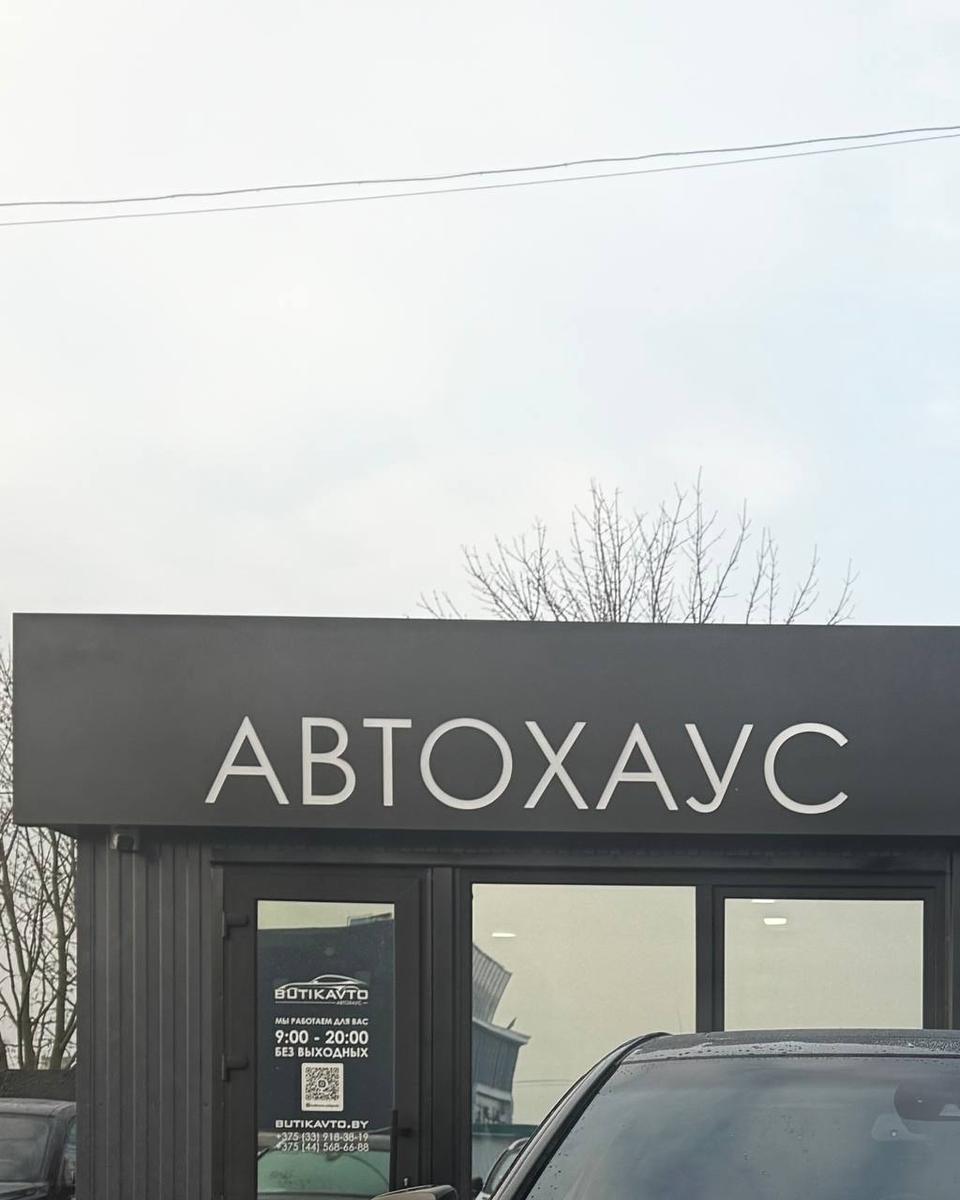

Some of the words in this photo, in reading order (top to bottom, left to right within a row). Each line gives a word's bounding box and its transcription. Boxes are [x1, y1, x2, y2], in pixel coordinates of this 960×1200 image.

[205, 716, 849, 815] АВТОХАУС
[274, 988, 369, 1000] BUTIKAVTO
[275, 1017, 289, 1025] МЫ
[291, 1017, 332, 1026] РАБОТАЕМ
[333, 1018, 351, 1026] ДЛЯ
[275, 1029, 309, 1044] 9:00
[325, 1029, 369, 1045] 20:00
[274, 1046, 295, 1058] БЕЗ
[297, 1047, 368, 1059] ВЫХОДНЫХ
[275, 1120, 369, 1129] BUTIKAVTO.BY
[301, 1132, 320, 1142] (33)
[301, 1142, 320, 1152] (44)
